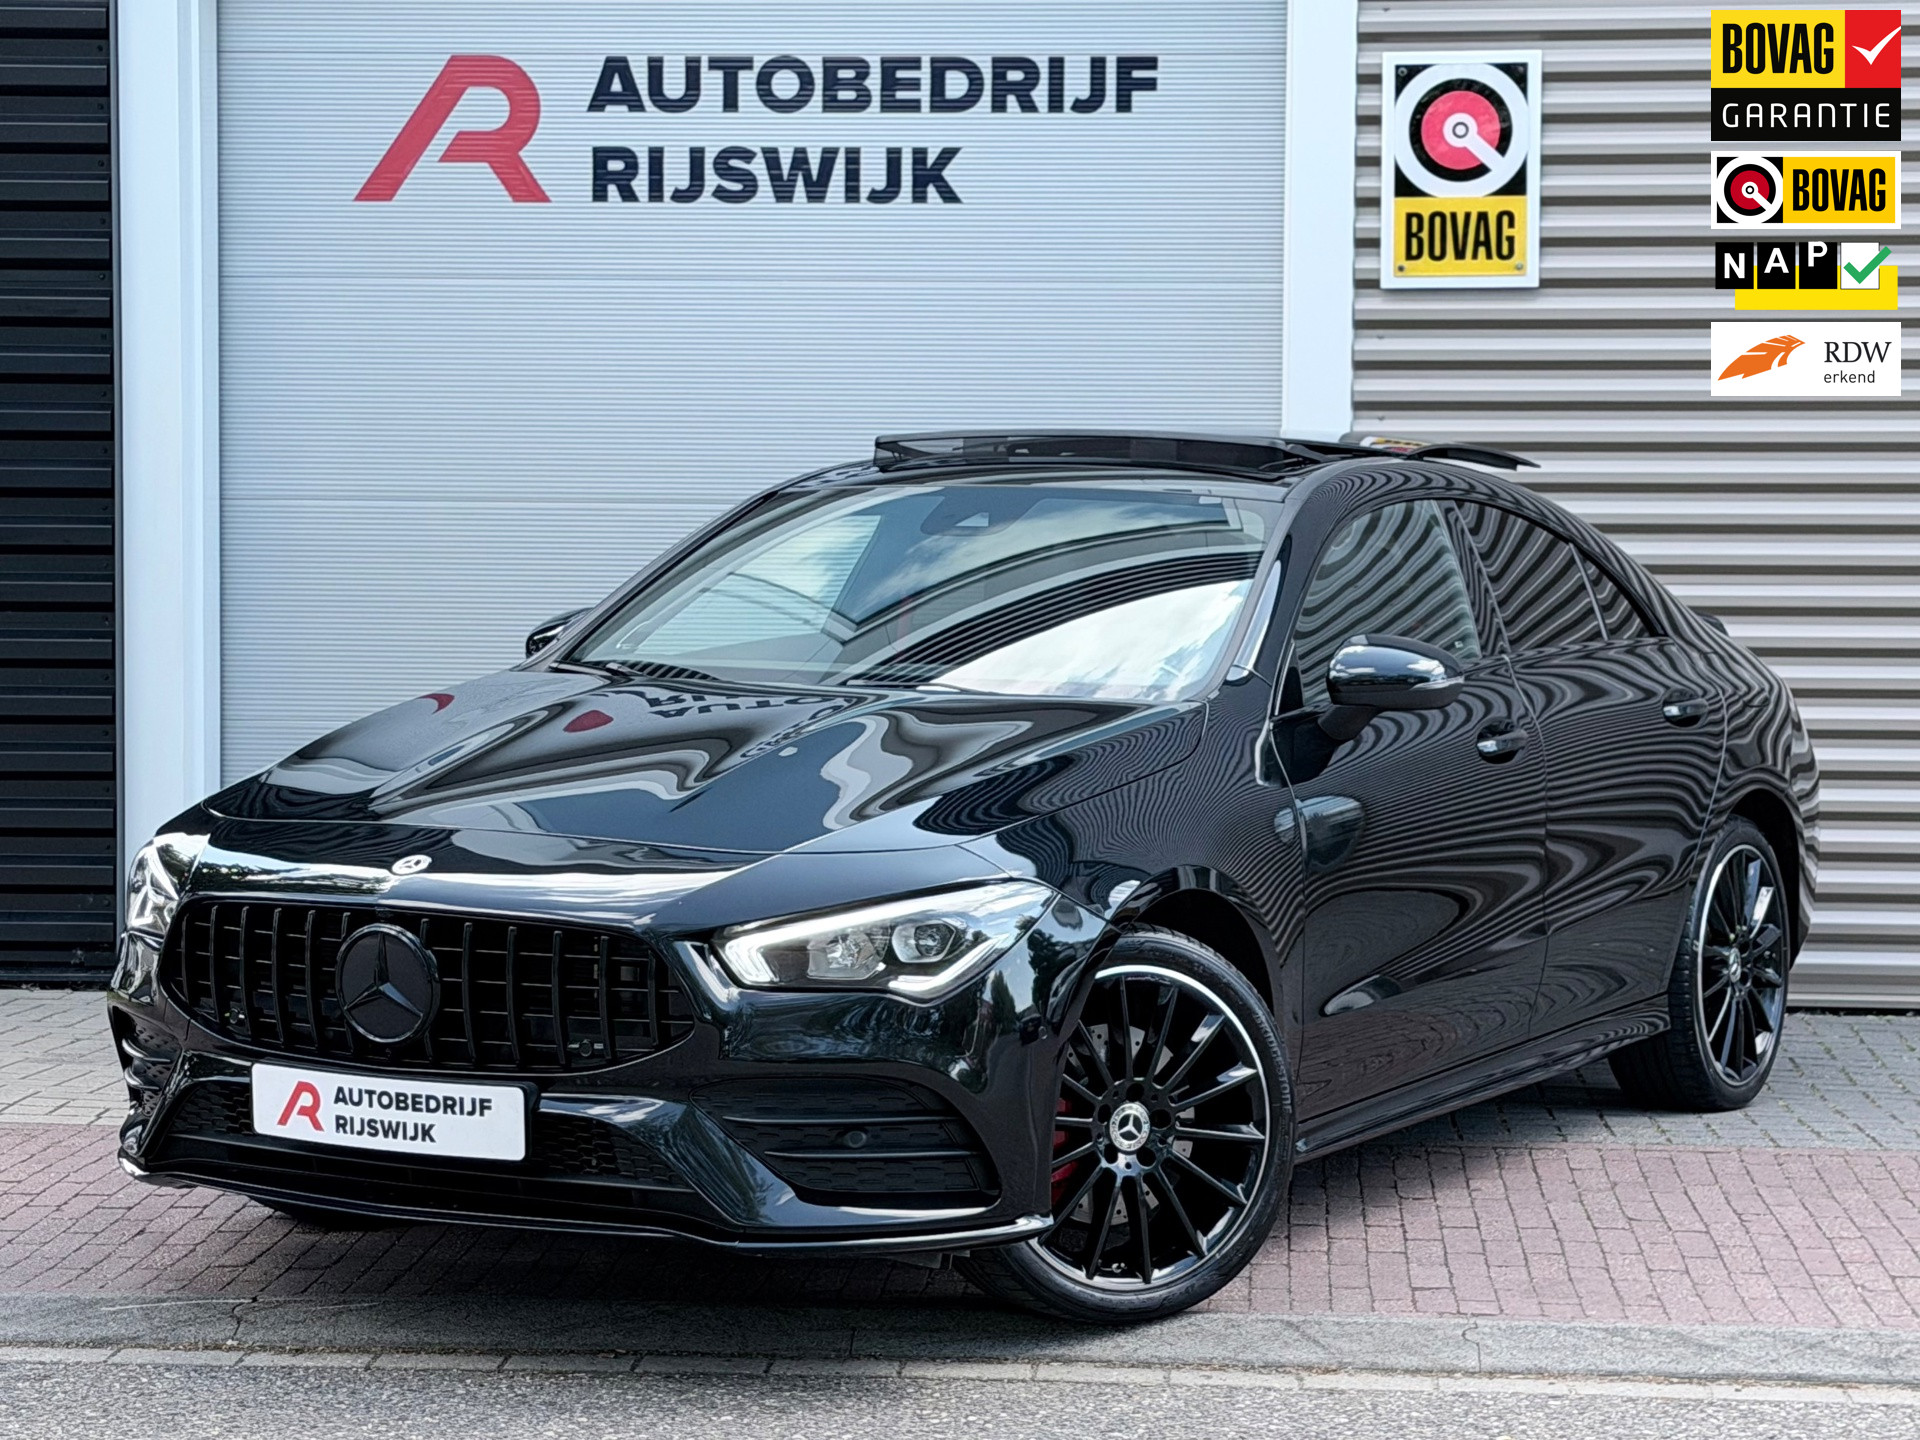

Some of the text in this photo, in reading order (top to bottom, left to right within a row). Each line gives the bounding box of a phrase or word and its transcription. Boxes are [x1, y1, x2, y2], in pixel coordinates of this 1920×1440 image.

[587, 55, 1159, 114] AUTOBEDRIJF
[591, 146, 963, 204] RIJSWIJK
[1404, 210, 1516, 262] BOVAG
[333, 1086, 493, 1117] AUTOBEDRIJF
[334, 1115, 437, 1144] RIJSWIJK
